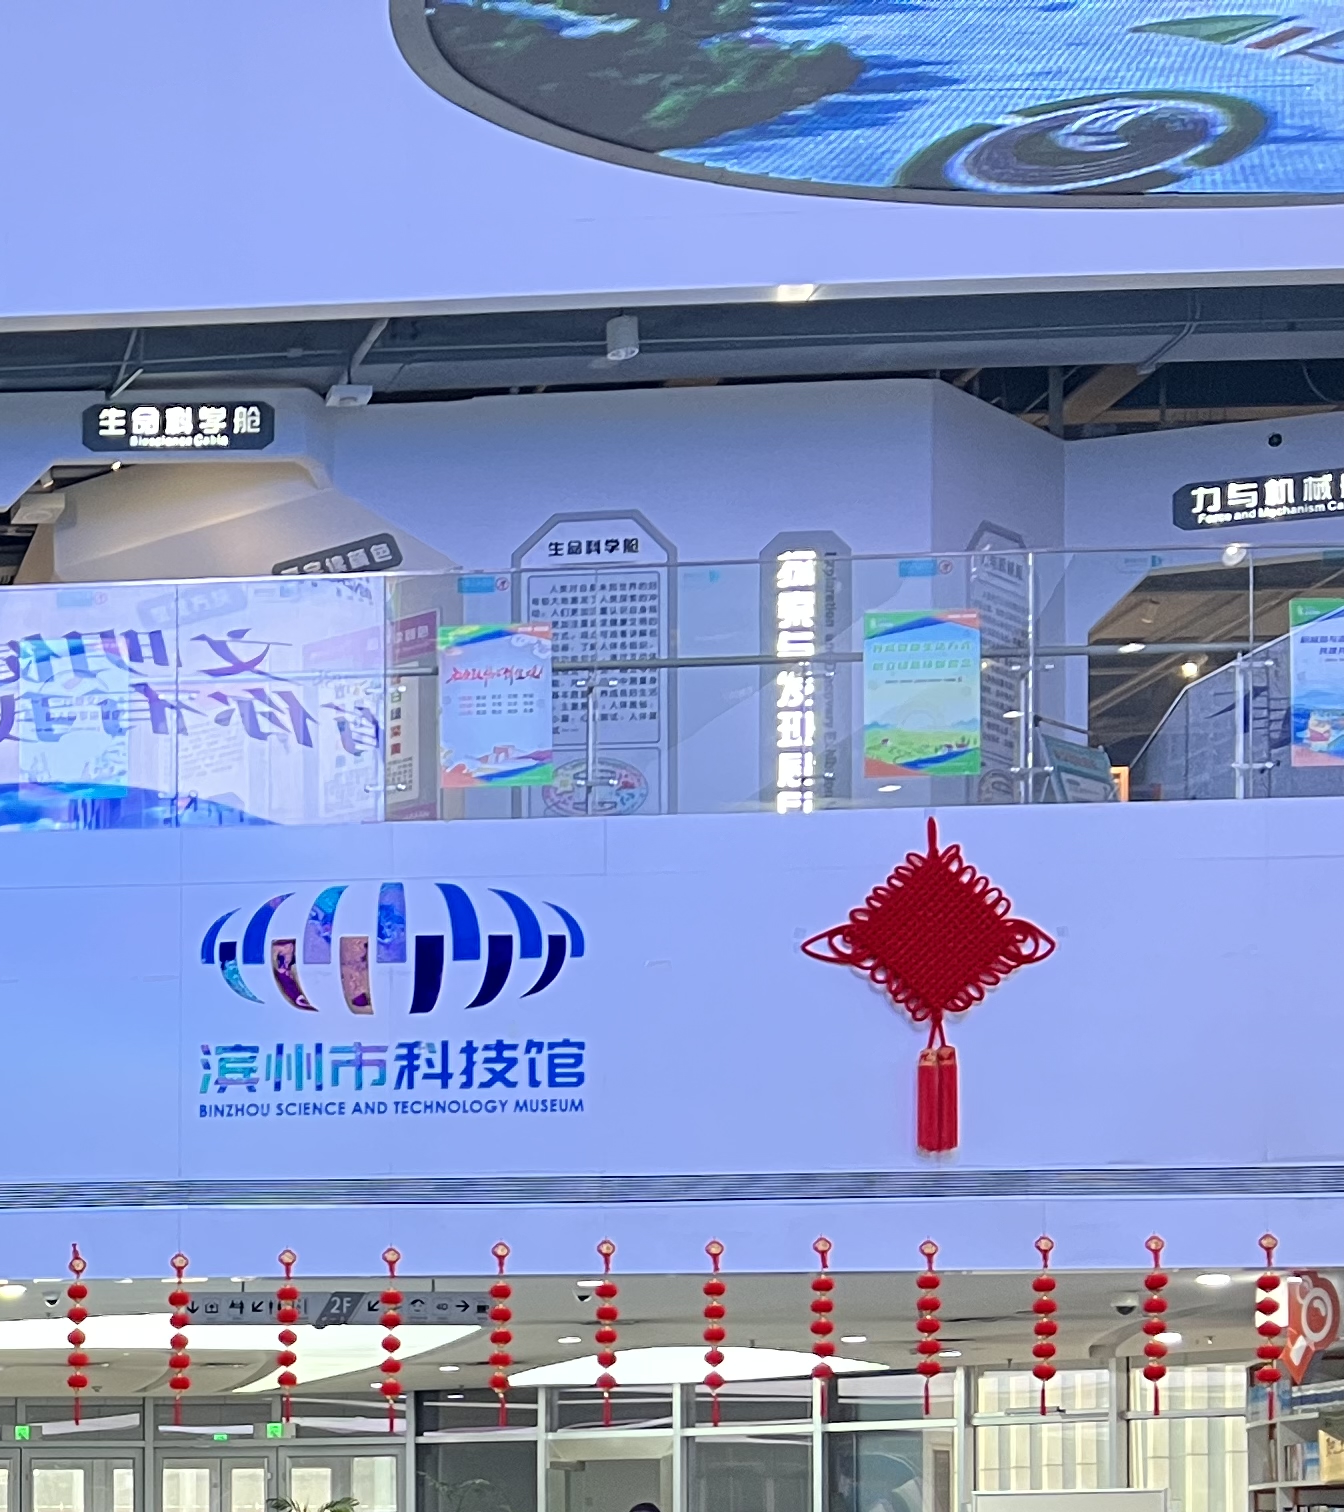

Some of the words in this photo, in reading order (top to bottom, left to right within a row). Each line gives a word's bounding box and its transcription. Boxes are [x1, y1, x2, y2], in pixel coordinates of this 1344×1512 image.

[98, 406, 261, 436] 生命科学舱
[1190, 472, 1344, 515] 力与机械
[1233, 507, 1257, 520] and
[548, 538, 639, 558] 生命科学舱
[199, 1038, 587, 1094] 滨州市科技馆
[199, 1103, 271, 1118] BINZHOU
[275, 1102, 346, 1117] SCIENCE
[350, 1101, 388, 1116] AND
[392, 1099, 509, 1115] TECHNOLOGY
[513, 1098, 585, 1113] MUSEUM
[330, 1296, 352, 1314] 2F
